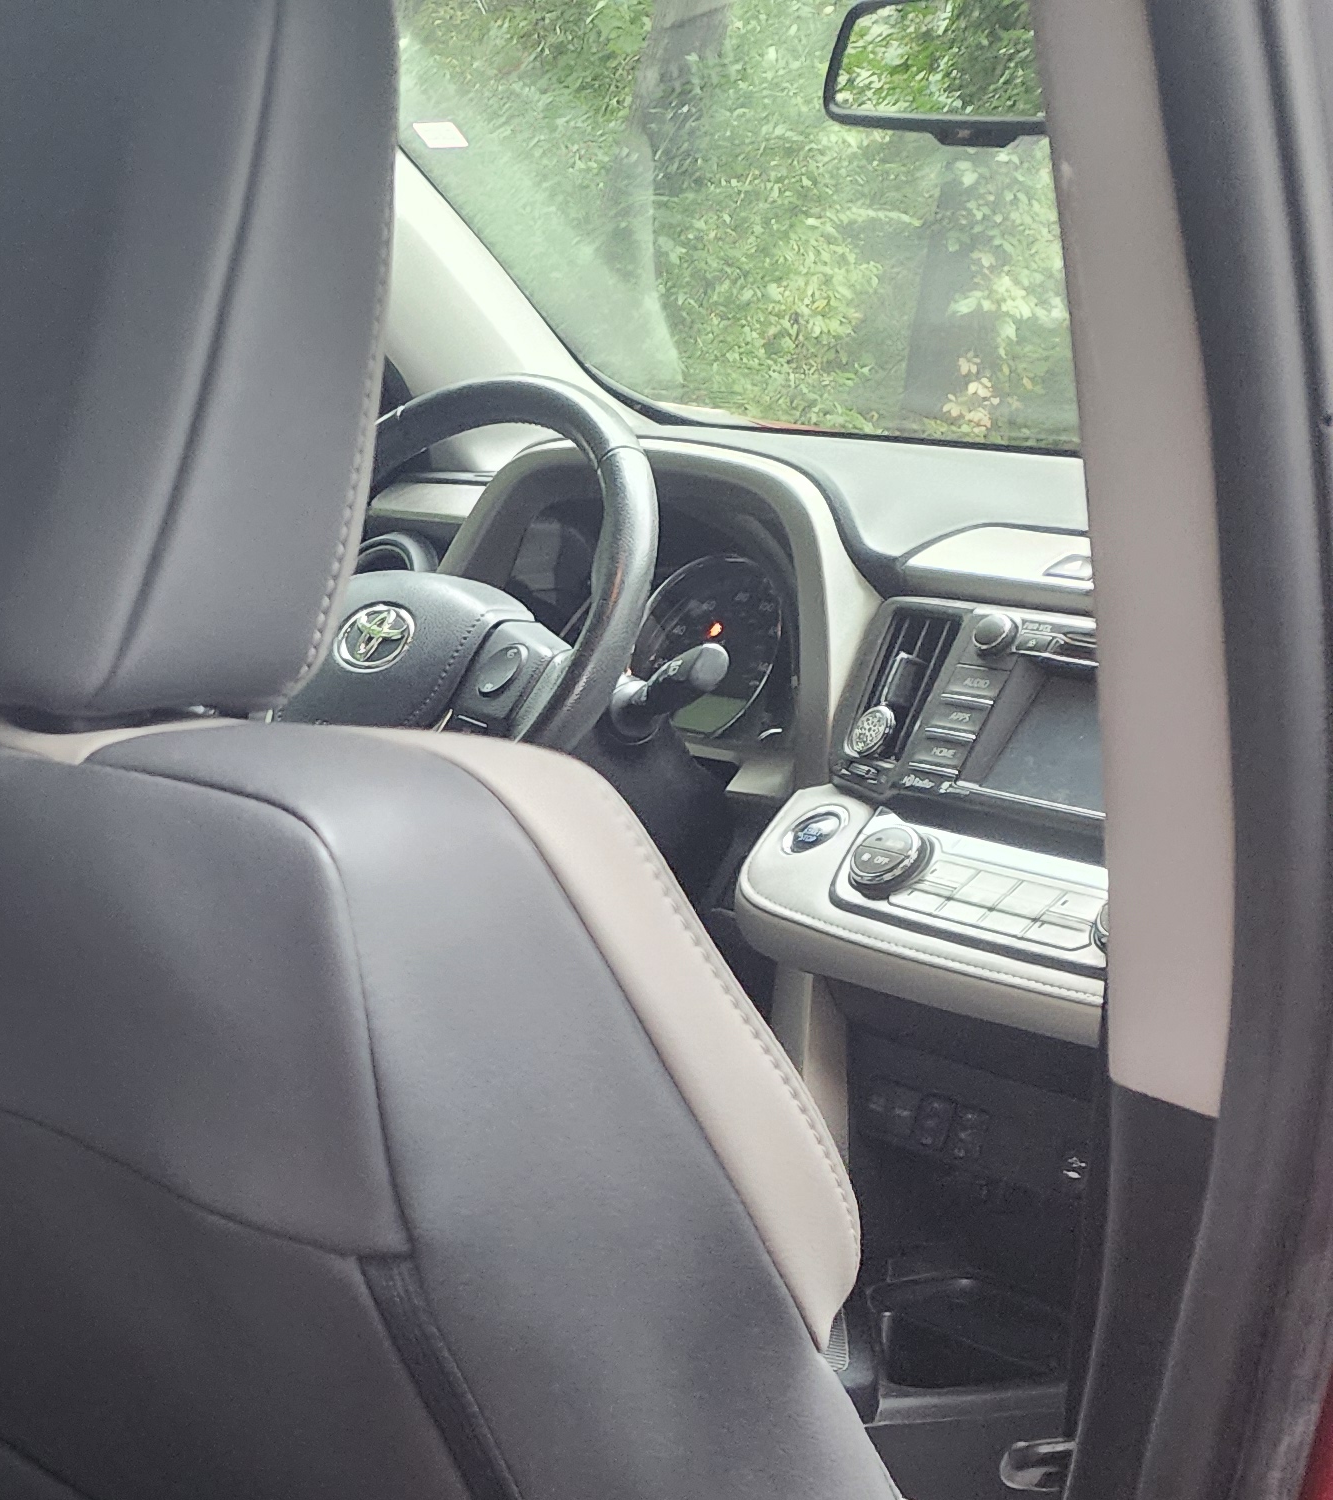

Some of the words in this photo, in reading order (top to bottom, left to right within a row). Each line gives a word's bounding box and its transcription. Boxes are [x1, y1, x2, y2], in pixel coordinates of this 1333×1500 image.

[963, 677, 990, 689] AUDIO
[948, 711, 972, 723] APPS
[931, 746, 957, 759] HOME
